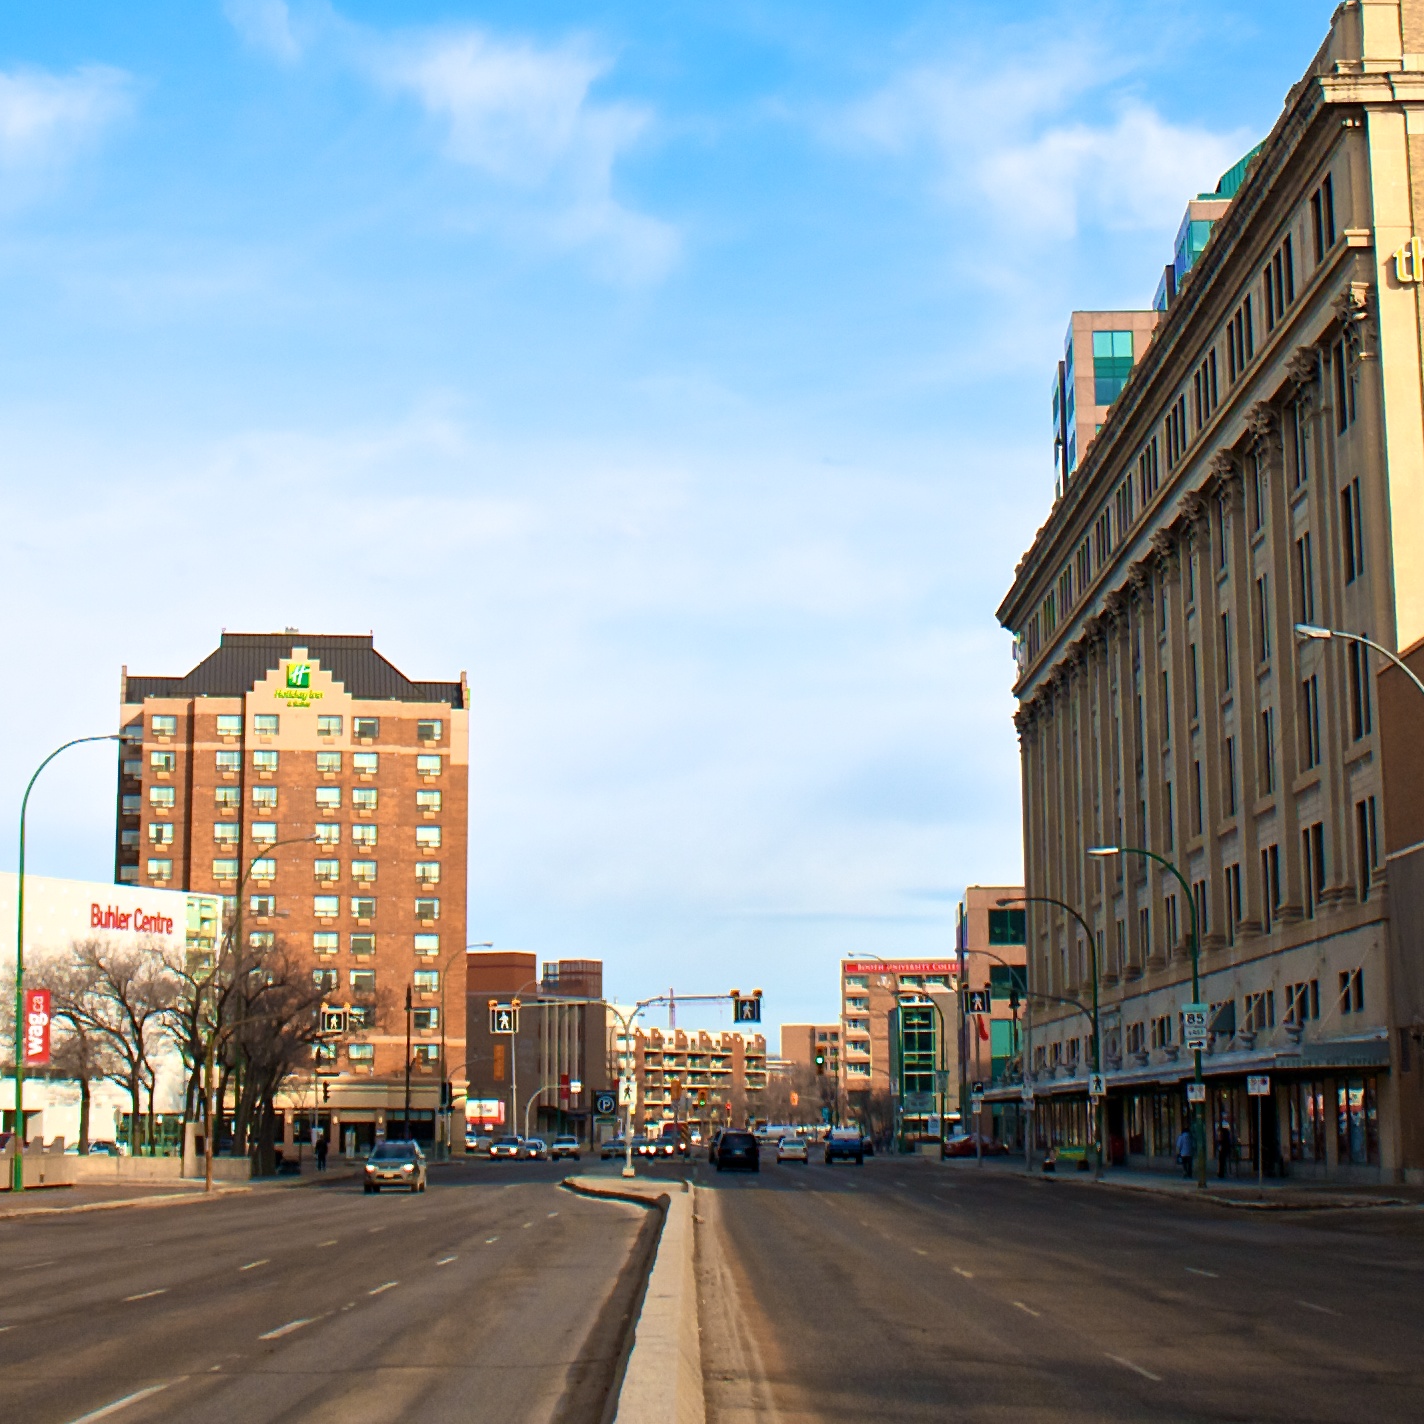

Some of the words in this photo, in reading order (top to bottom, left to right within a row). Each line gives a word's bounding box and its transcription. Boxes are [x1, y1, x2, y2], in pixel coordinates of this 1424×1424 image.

[90, 903, 132, 931] Buhler
[134, 907, 174, 935] Centre
[28, 995, 49, 1056] wag.ca
